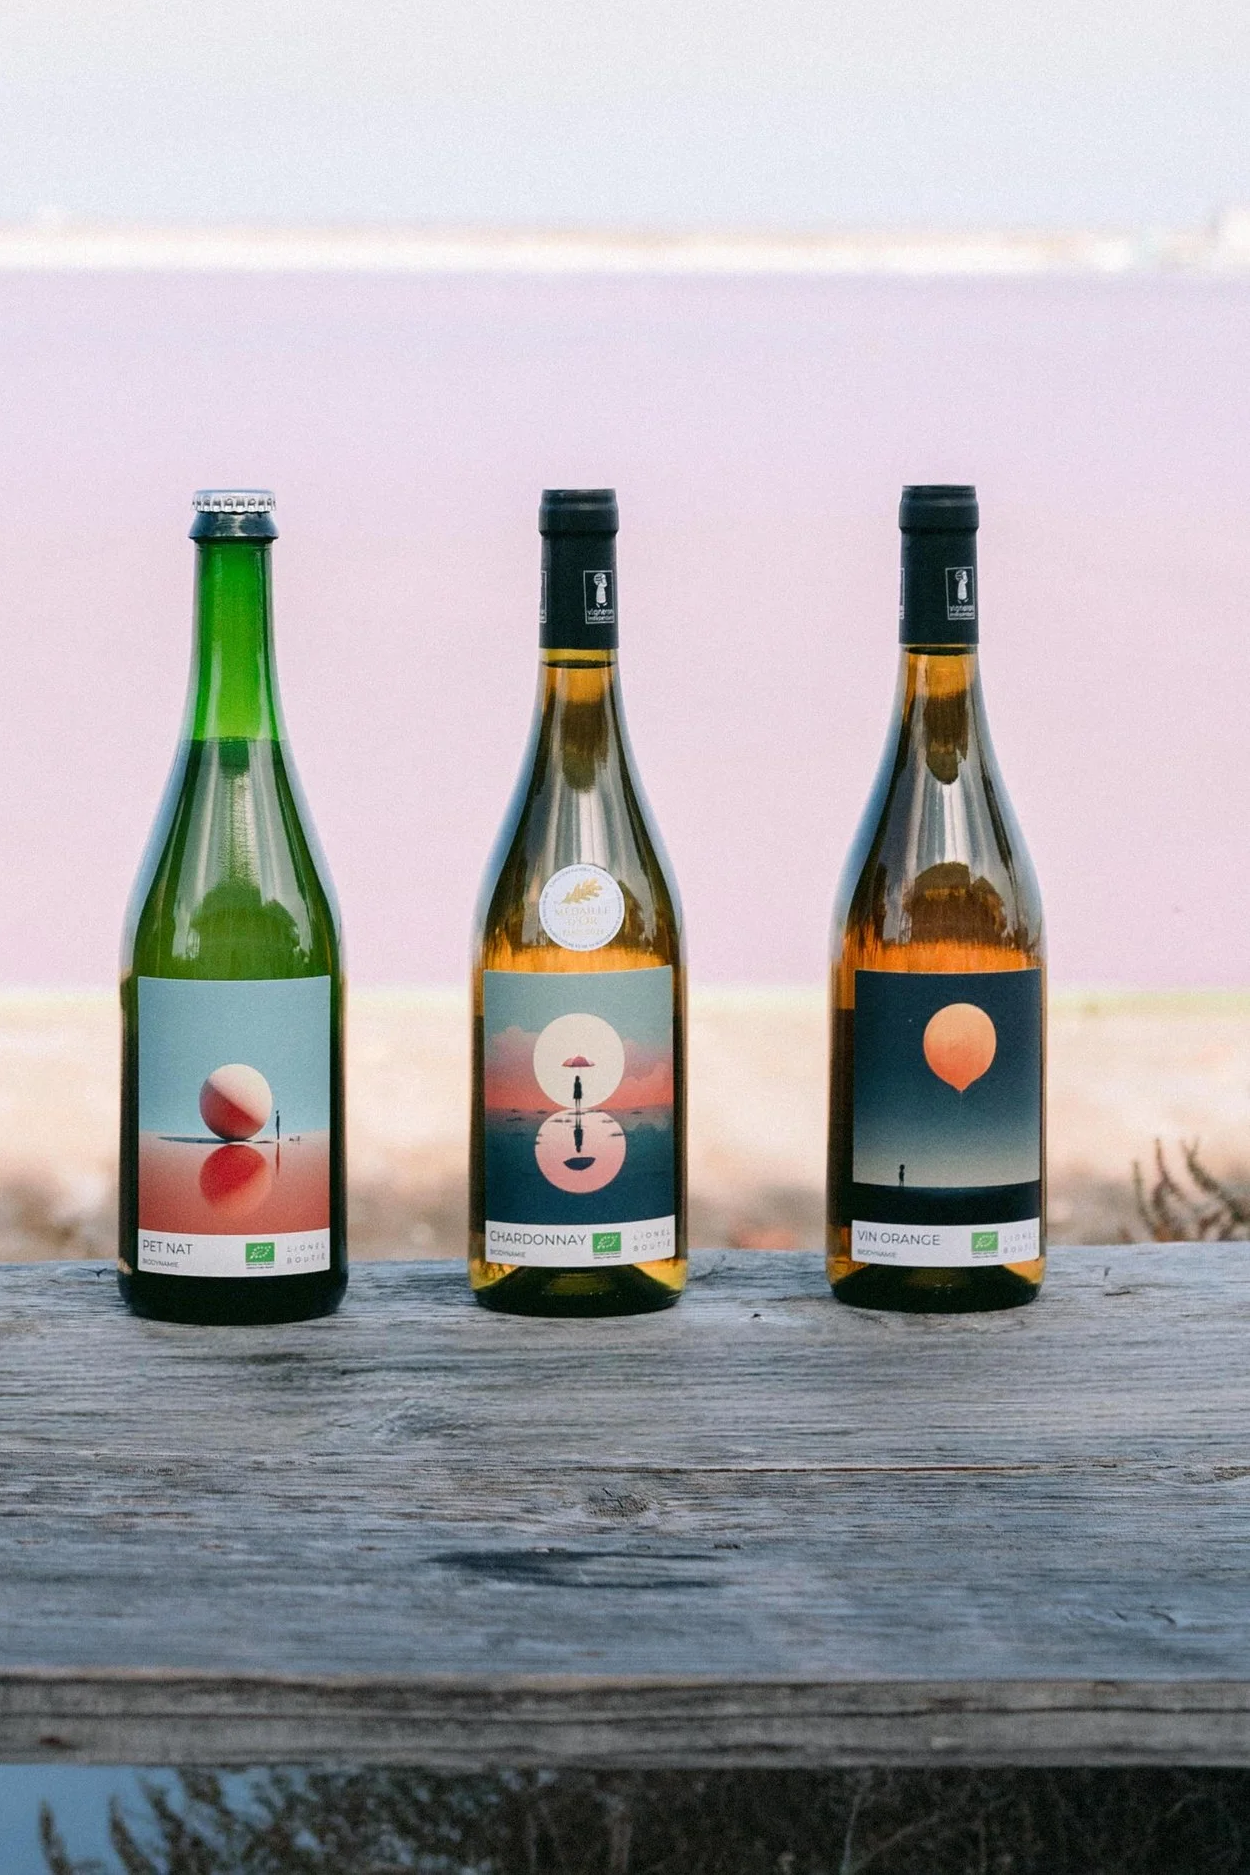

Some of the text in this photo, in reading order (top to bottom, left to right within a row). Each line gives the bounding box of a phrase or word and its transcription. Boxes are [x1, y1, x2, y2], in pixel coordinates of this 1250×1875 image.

[489, 1230, 587, 1246] CHARDONNAY
[633, 1227, 671, 1241] LIONEL
[857, 1230, 941, 1246] VIN ORANGE
[143, 1239, 193, 1255] PET NAT
[286, 1242, 326, 1253] LIONEL
